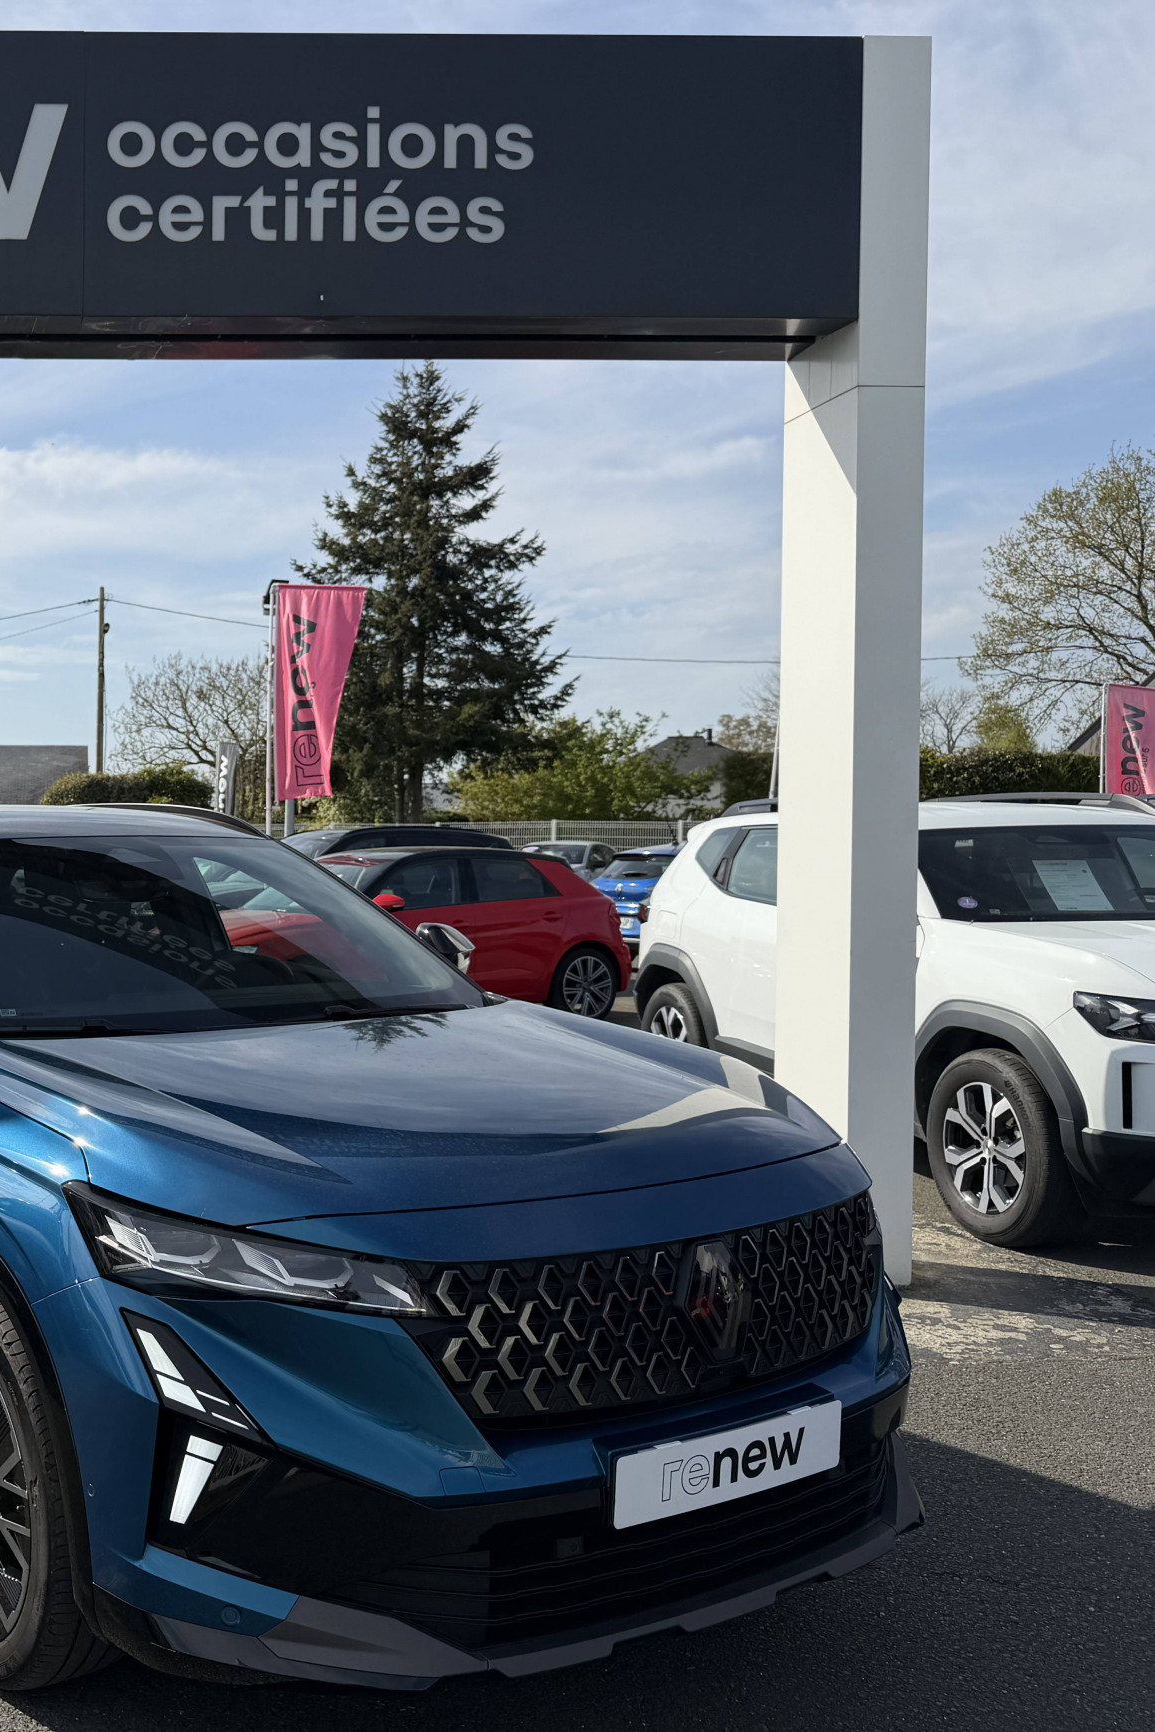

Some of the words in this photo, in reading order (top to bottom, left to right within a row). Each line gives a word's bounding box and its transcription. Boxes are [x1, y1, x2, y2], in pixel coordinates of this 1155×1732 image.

[106, 105, 535, 171] occasions
[106, 178, 506, 244] certifiées
[1121, 703, 1146, 797] enew
[662, 1426, 805, 1502] renew
